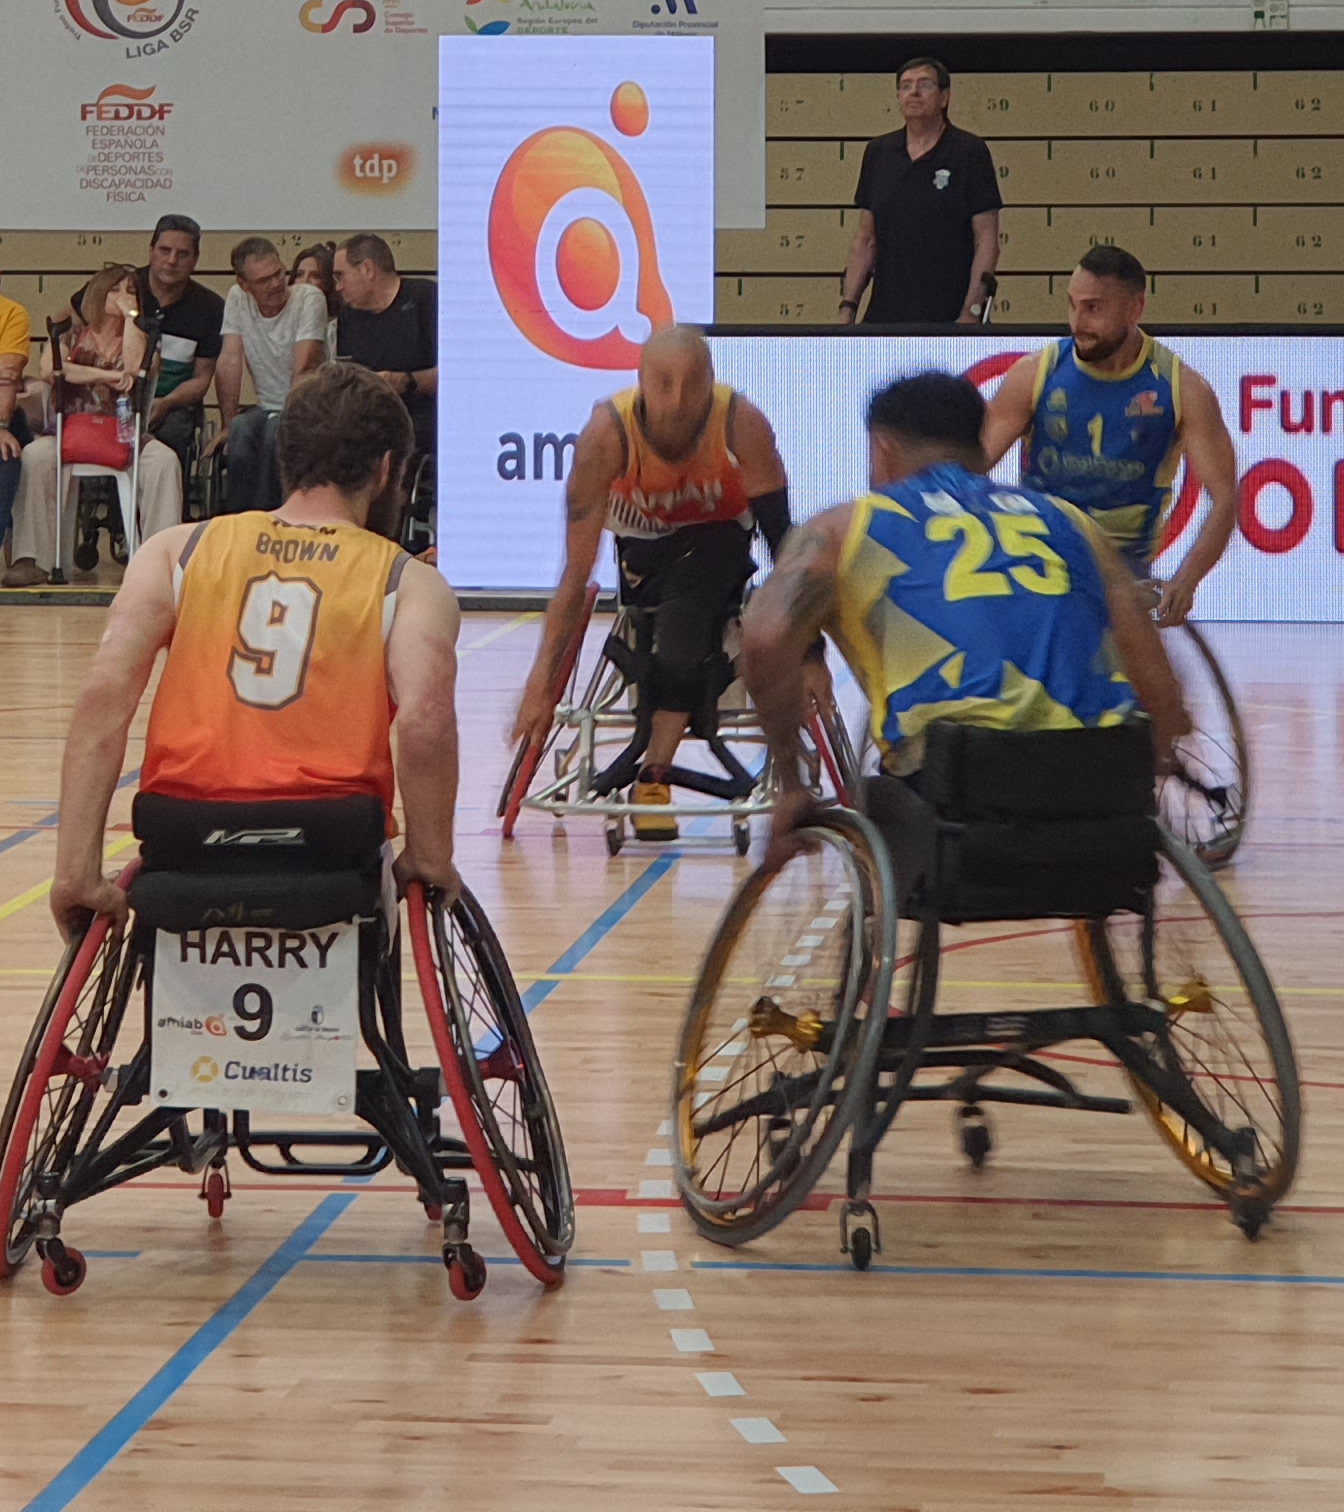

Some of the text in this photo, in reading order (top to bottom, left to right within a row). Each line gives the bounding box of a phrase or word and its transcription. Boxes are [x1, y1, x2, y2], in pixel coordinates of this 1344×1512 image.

[126, 7, 199, 59] LIGA BSR
[81, 103, 174, 121] FEDDF
[86, 123, 166, 136] FEDERACIÓN
[92, 137, 159, 150] ESPAÑOLA
[97, 152, 164, 163] DEPORTES
[353, 152, 398, 181] tdp
[86, 165, 156, 176] PERSONAS
[80, 178, 173, 189] DISCAPACIDAD
[106, 190, 146, 202] FÍSICA
[1087, 412, 1103, 457] 1
[256, 531, 340, 564] BROWN
[925, 514, 1070, 601] 25
[226, 571, 323, 711] 9
[180, 931, 340, 969] HARRY
[158, 1016, 203, 1030] amiab
[232, 983, 274, 1042] 9
[224, 1060, 313, 1084] Cualtis
